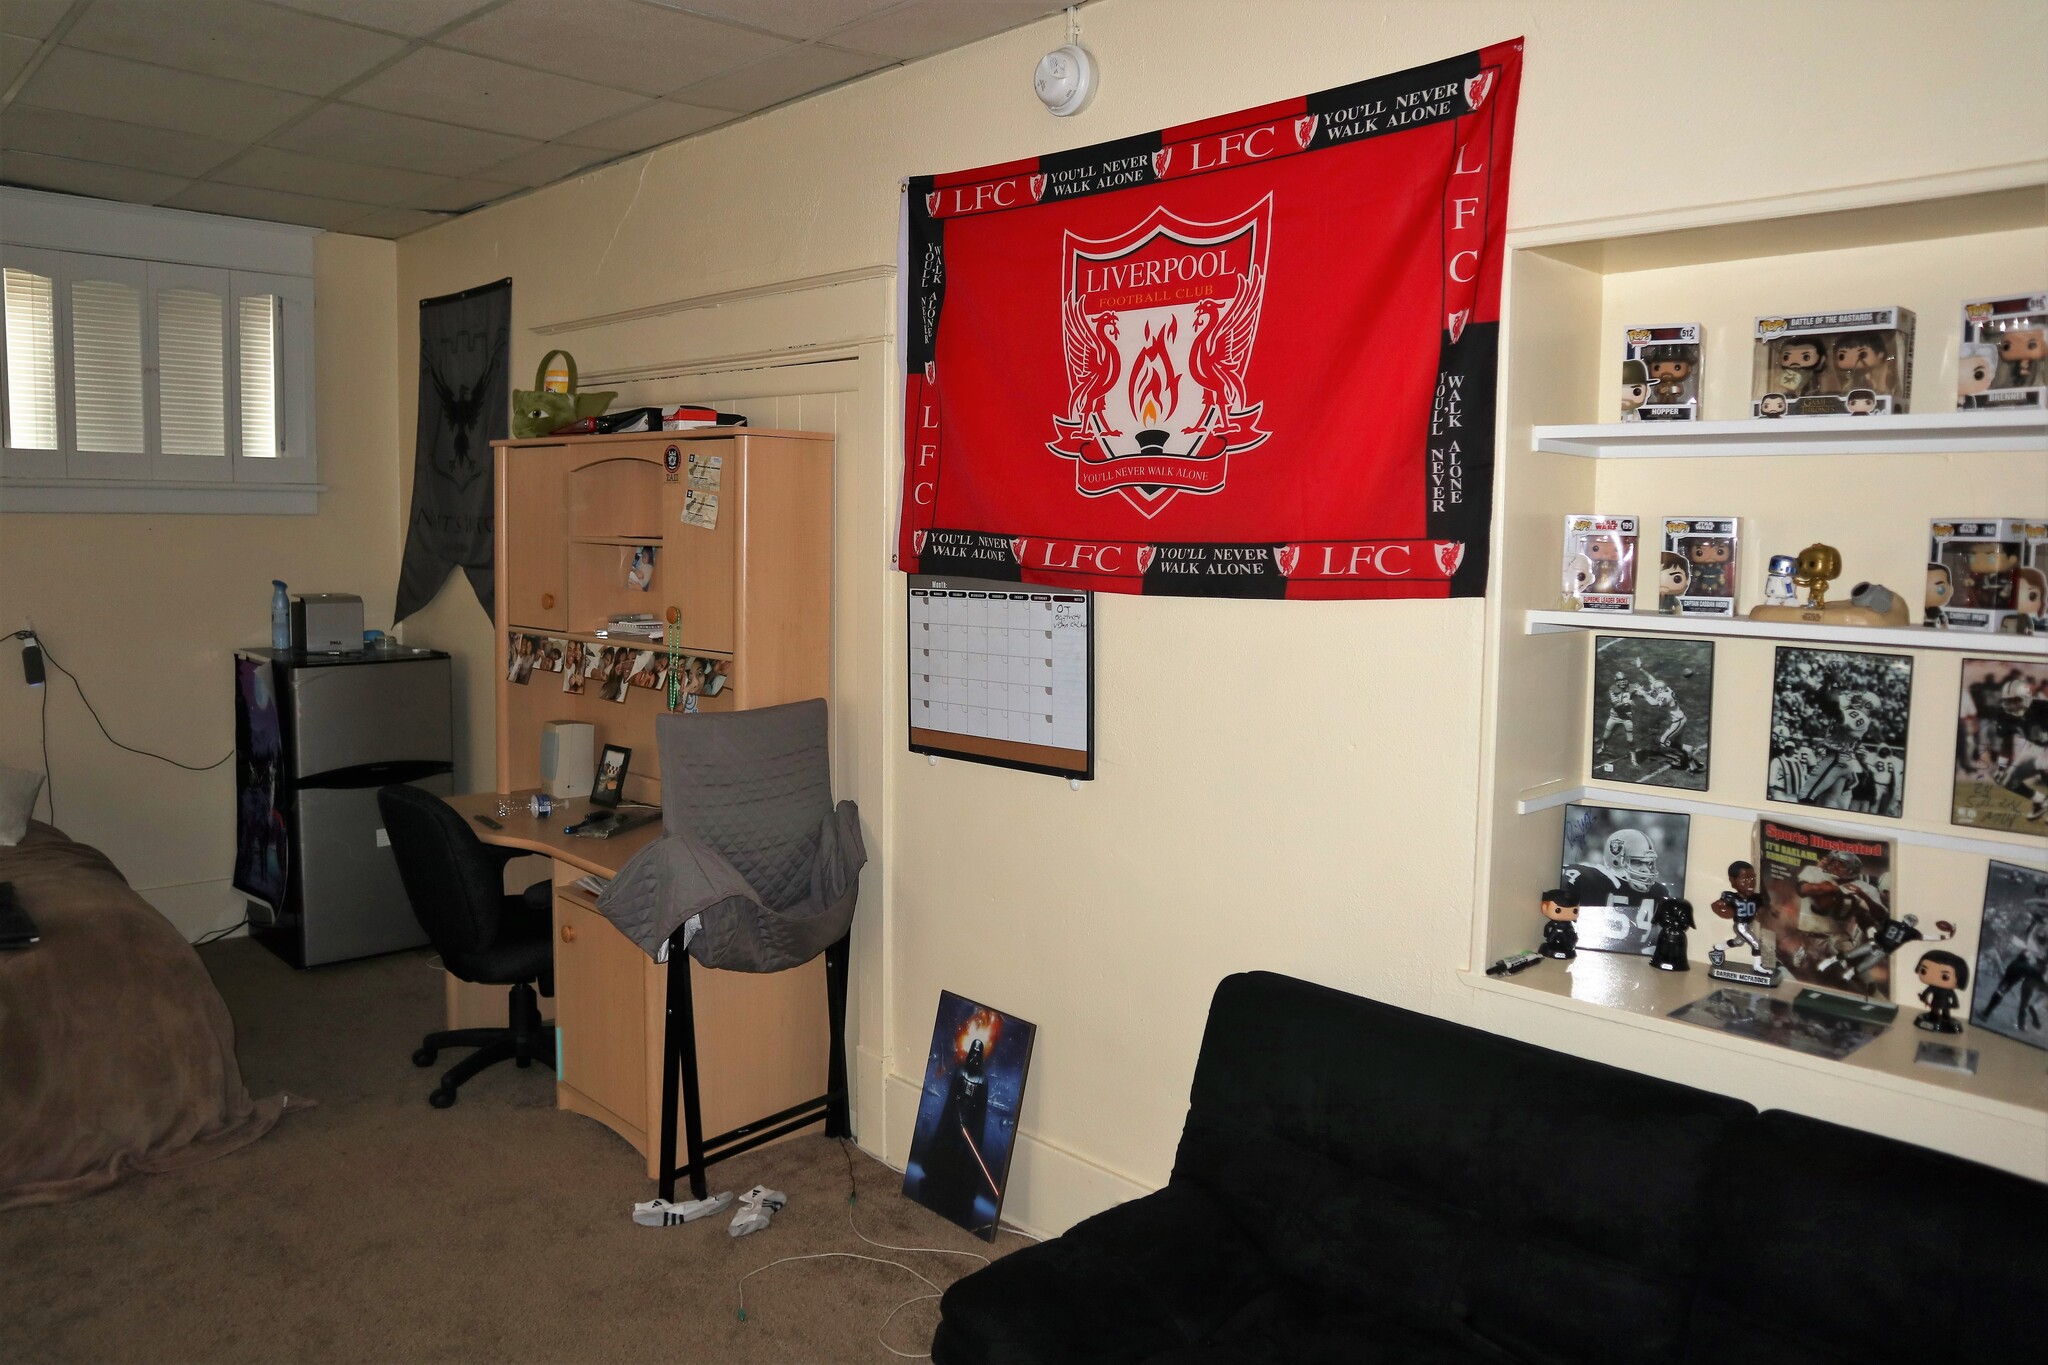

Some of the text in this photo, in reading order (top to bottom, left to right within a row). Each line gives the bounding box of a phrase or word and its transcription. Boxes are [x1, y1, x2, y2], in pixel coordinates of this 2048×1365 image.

[1324, 81, 1459, 127] YOU'LL NEVER
[1327, 100, 1451, 141] WALK ALONE
[1190, 124, 1276, 171] LFC
[1050, 153, 1148, 185] YOU'LL NEVER
[1053, 169, 1144, 196] WALK ALONE
[953, 181, 1017, 213] LFC
[1449, 142, 1484, 284] LFC
[1087, 249, 1237, 294] LIVERPOOL
[1098, 284, 1213, 308] FOOTBALL CLUB
[1681, 329, 1694, 338] 512
[1791, 317, 1814, 326] BATTLE
[1825, 315, 1837, 323] THE
[1447, 375, 1465, 504] WALK ALONE
[914, 405, 939, 505] LFC
[1082, 465, 1209, 483] YOU'LL NEVER WALK ALONE
[1431, 448, 1445, 513] NEVER
[930, 532, 1008, 549] YOU'LL NEVER
[931, 545, 1006, 562] WALK ALONE
[1159, 547, 1269, 561] YOU'LL NEVER
[1041, 542, 1123, 572] LFC
[1160, 561, 1265, 576] WALK ALONE
[1319, 545, 1411, 576] LFC
[1765, 824, 1882, 857] Sports Illustrated
[1606, 892, 1656, 943] 54
[1737, 902, 1756, 917] 20
[1886, 925, 1906, 943] 81
[1715, 970, 1738, 979] DARREN
